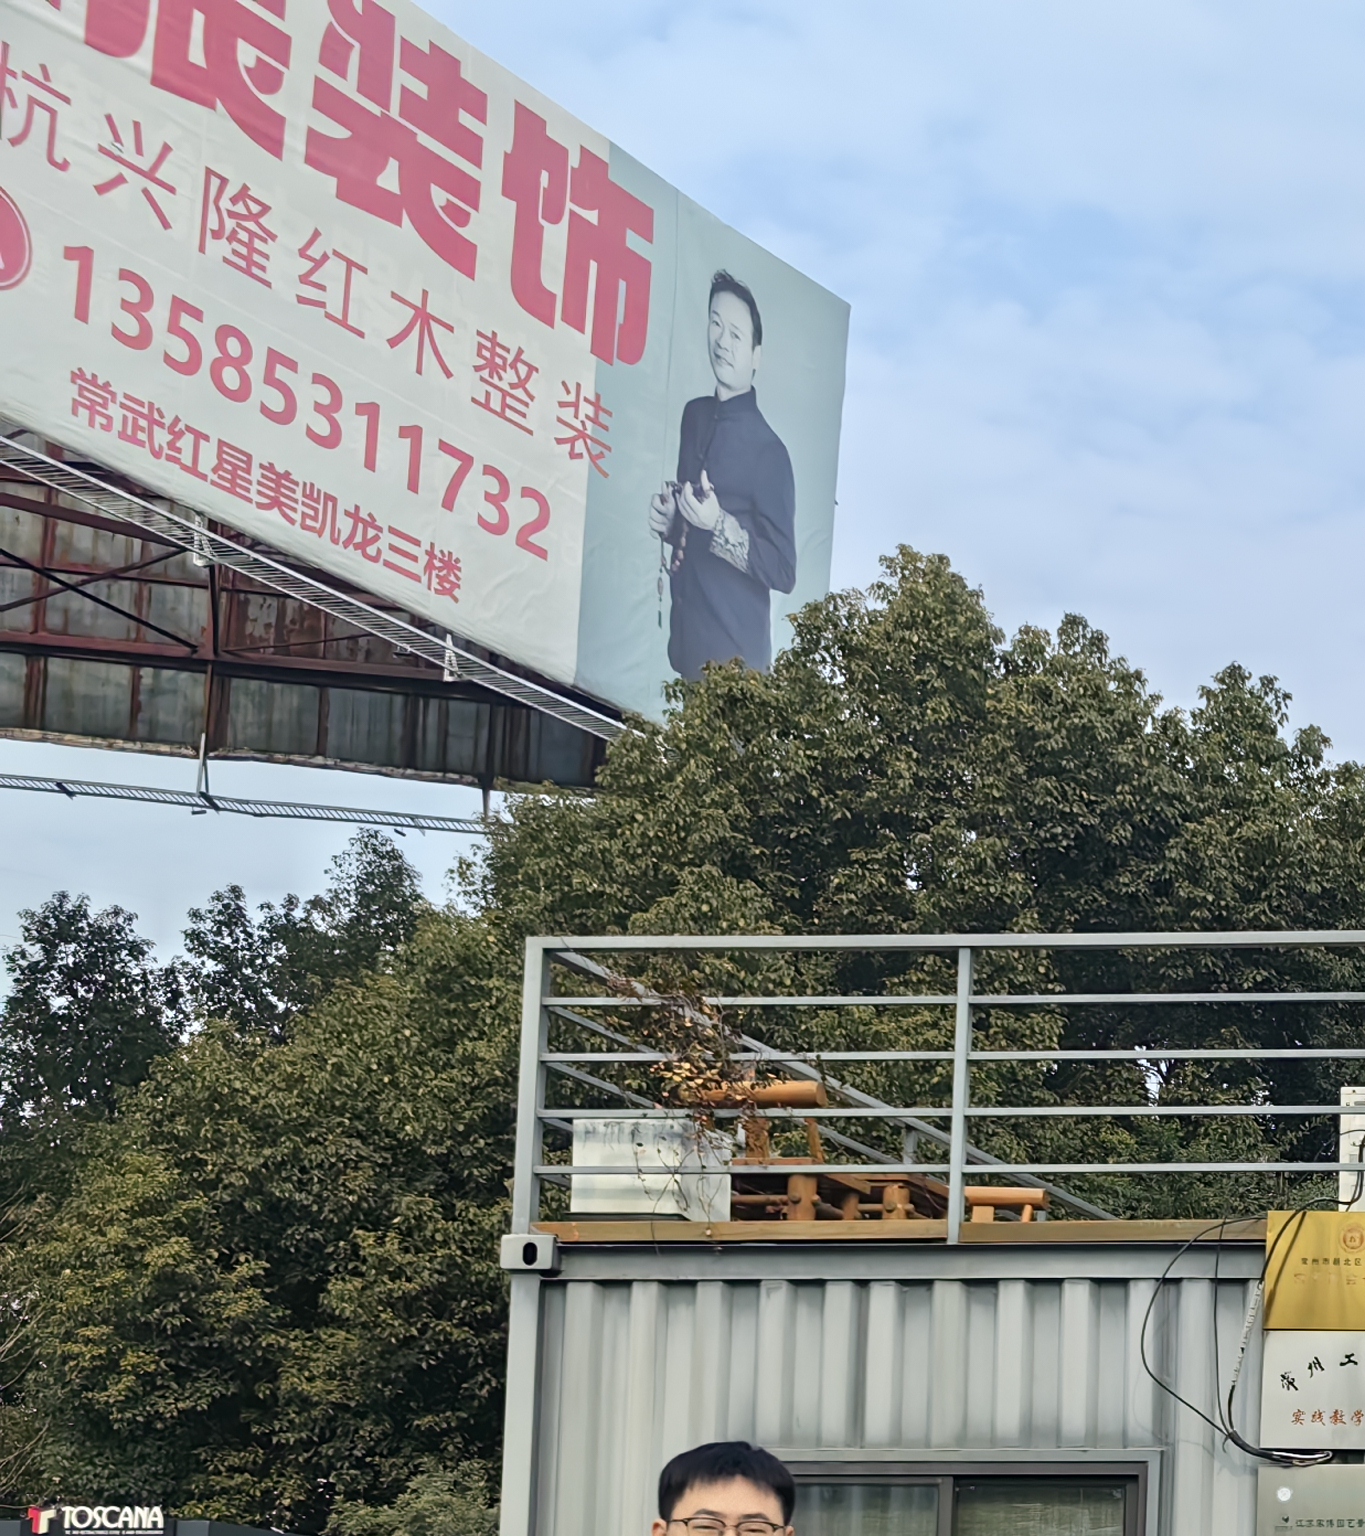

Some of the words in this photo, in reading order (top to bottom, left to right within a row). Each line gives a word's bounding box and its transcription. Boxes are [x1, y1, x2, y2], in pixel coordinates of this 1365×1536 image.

[62, 245, 551, 561] 13585311732
[69, 368, 463, 604] 常武红星美凯龙三楼
[61, 1505, 165, 1530] TOSCANA
